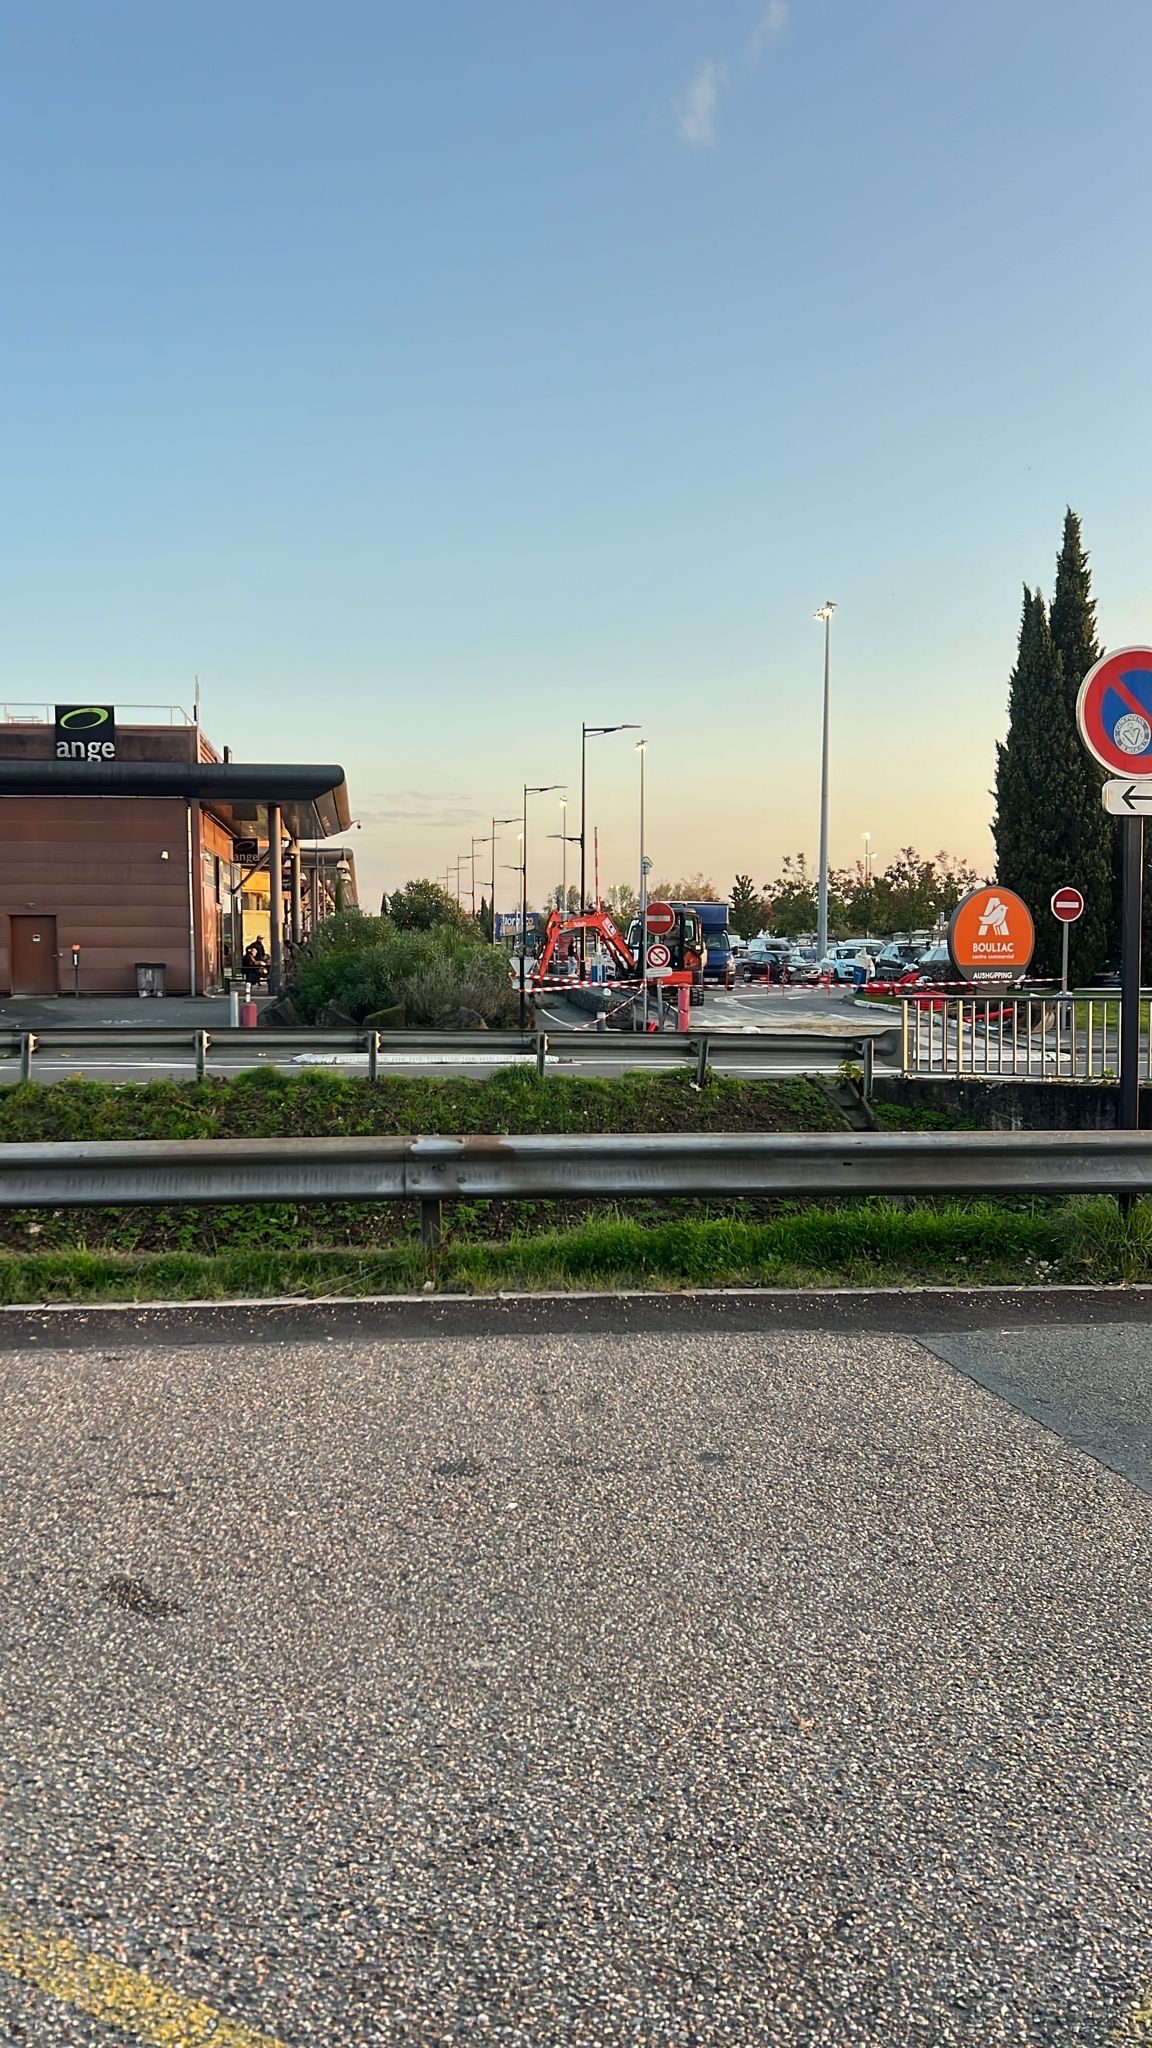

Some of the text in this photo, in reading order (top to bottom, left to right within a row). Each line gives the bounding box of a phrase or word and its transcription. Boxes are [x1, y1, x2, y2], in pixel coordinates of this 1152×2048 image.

[56, 741, 116, 763] ange
[234, 853, 260, 864] ange
[972, 942, 1014, 953] BOULIAC
